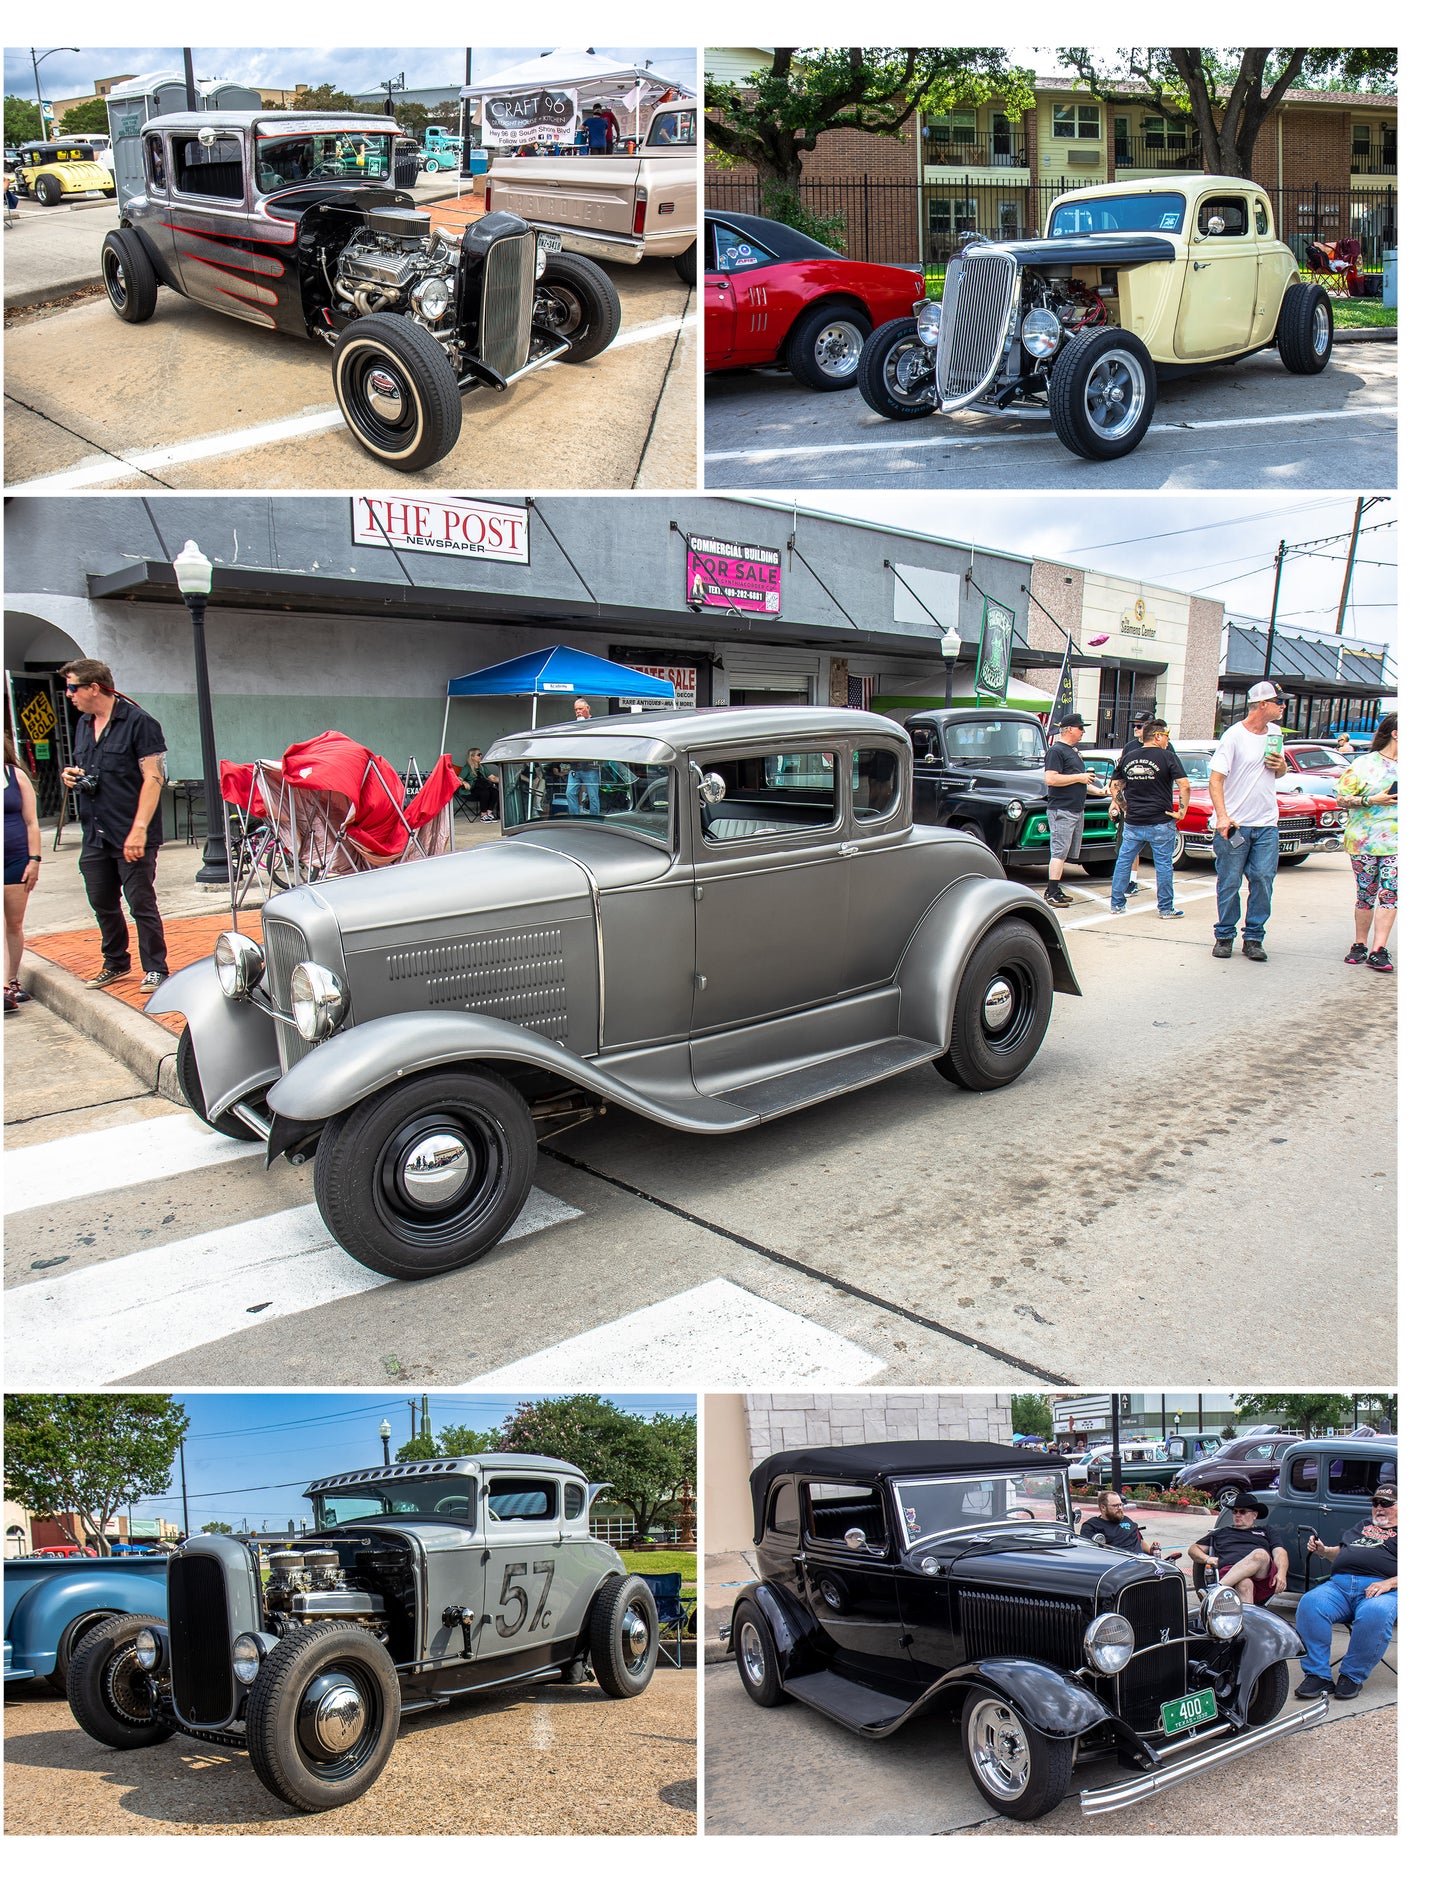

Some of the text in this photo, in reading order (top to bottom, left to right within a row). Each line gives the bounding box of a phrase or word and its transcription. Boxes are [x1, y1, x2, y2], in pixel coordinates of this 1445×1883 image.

[491, 96, 565, 117] CRAFT 96
[542, 115, 566, 124] KITCHEN
[489, 129, 500, 138] Hwy
[510, 130, 517, 138] @
[518, 127, 537, 137] South
[538, 125, 556, 133] Shore
[528, 135, 536, 143] on
[358, 497, 523, 550] THE POST
[406, 535, 486, 553] NEWSPAPER
[690, 537, 779, 564] COMMERCIAL BUILDING
[692, 555, 778, 585] FOR SALE
[1142, 624, 1157, 638] Center
[668, 667, 695, 691] SALE
[23, 693, 47, 722] WE
[636, 699, 661, 707] ANTIQUES
[28, 703, 49, 732] BUY
[32, 712, 56, 740] GOLD
[1179, 1698, 1202, 1720] 400
